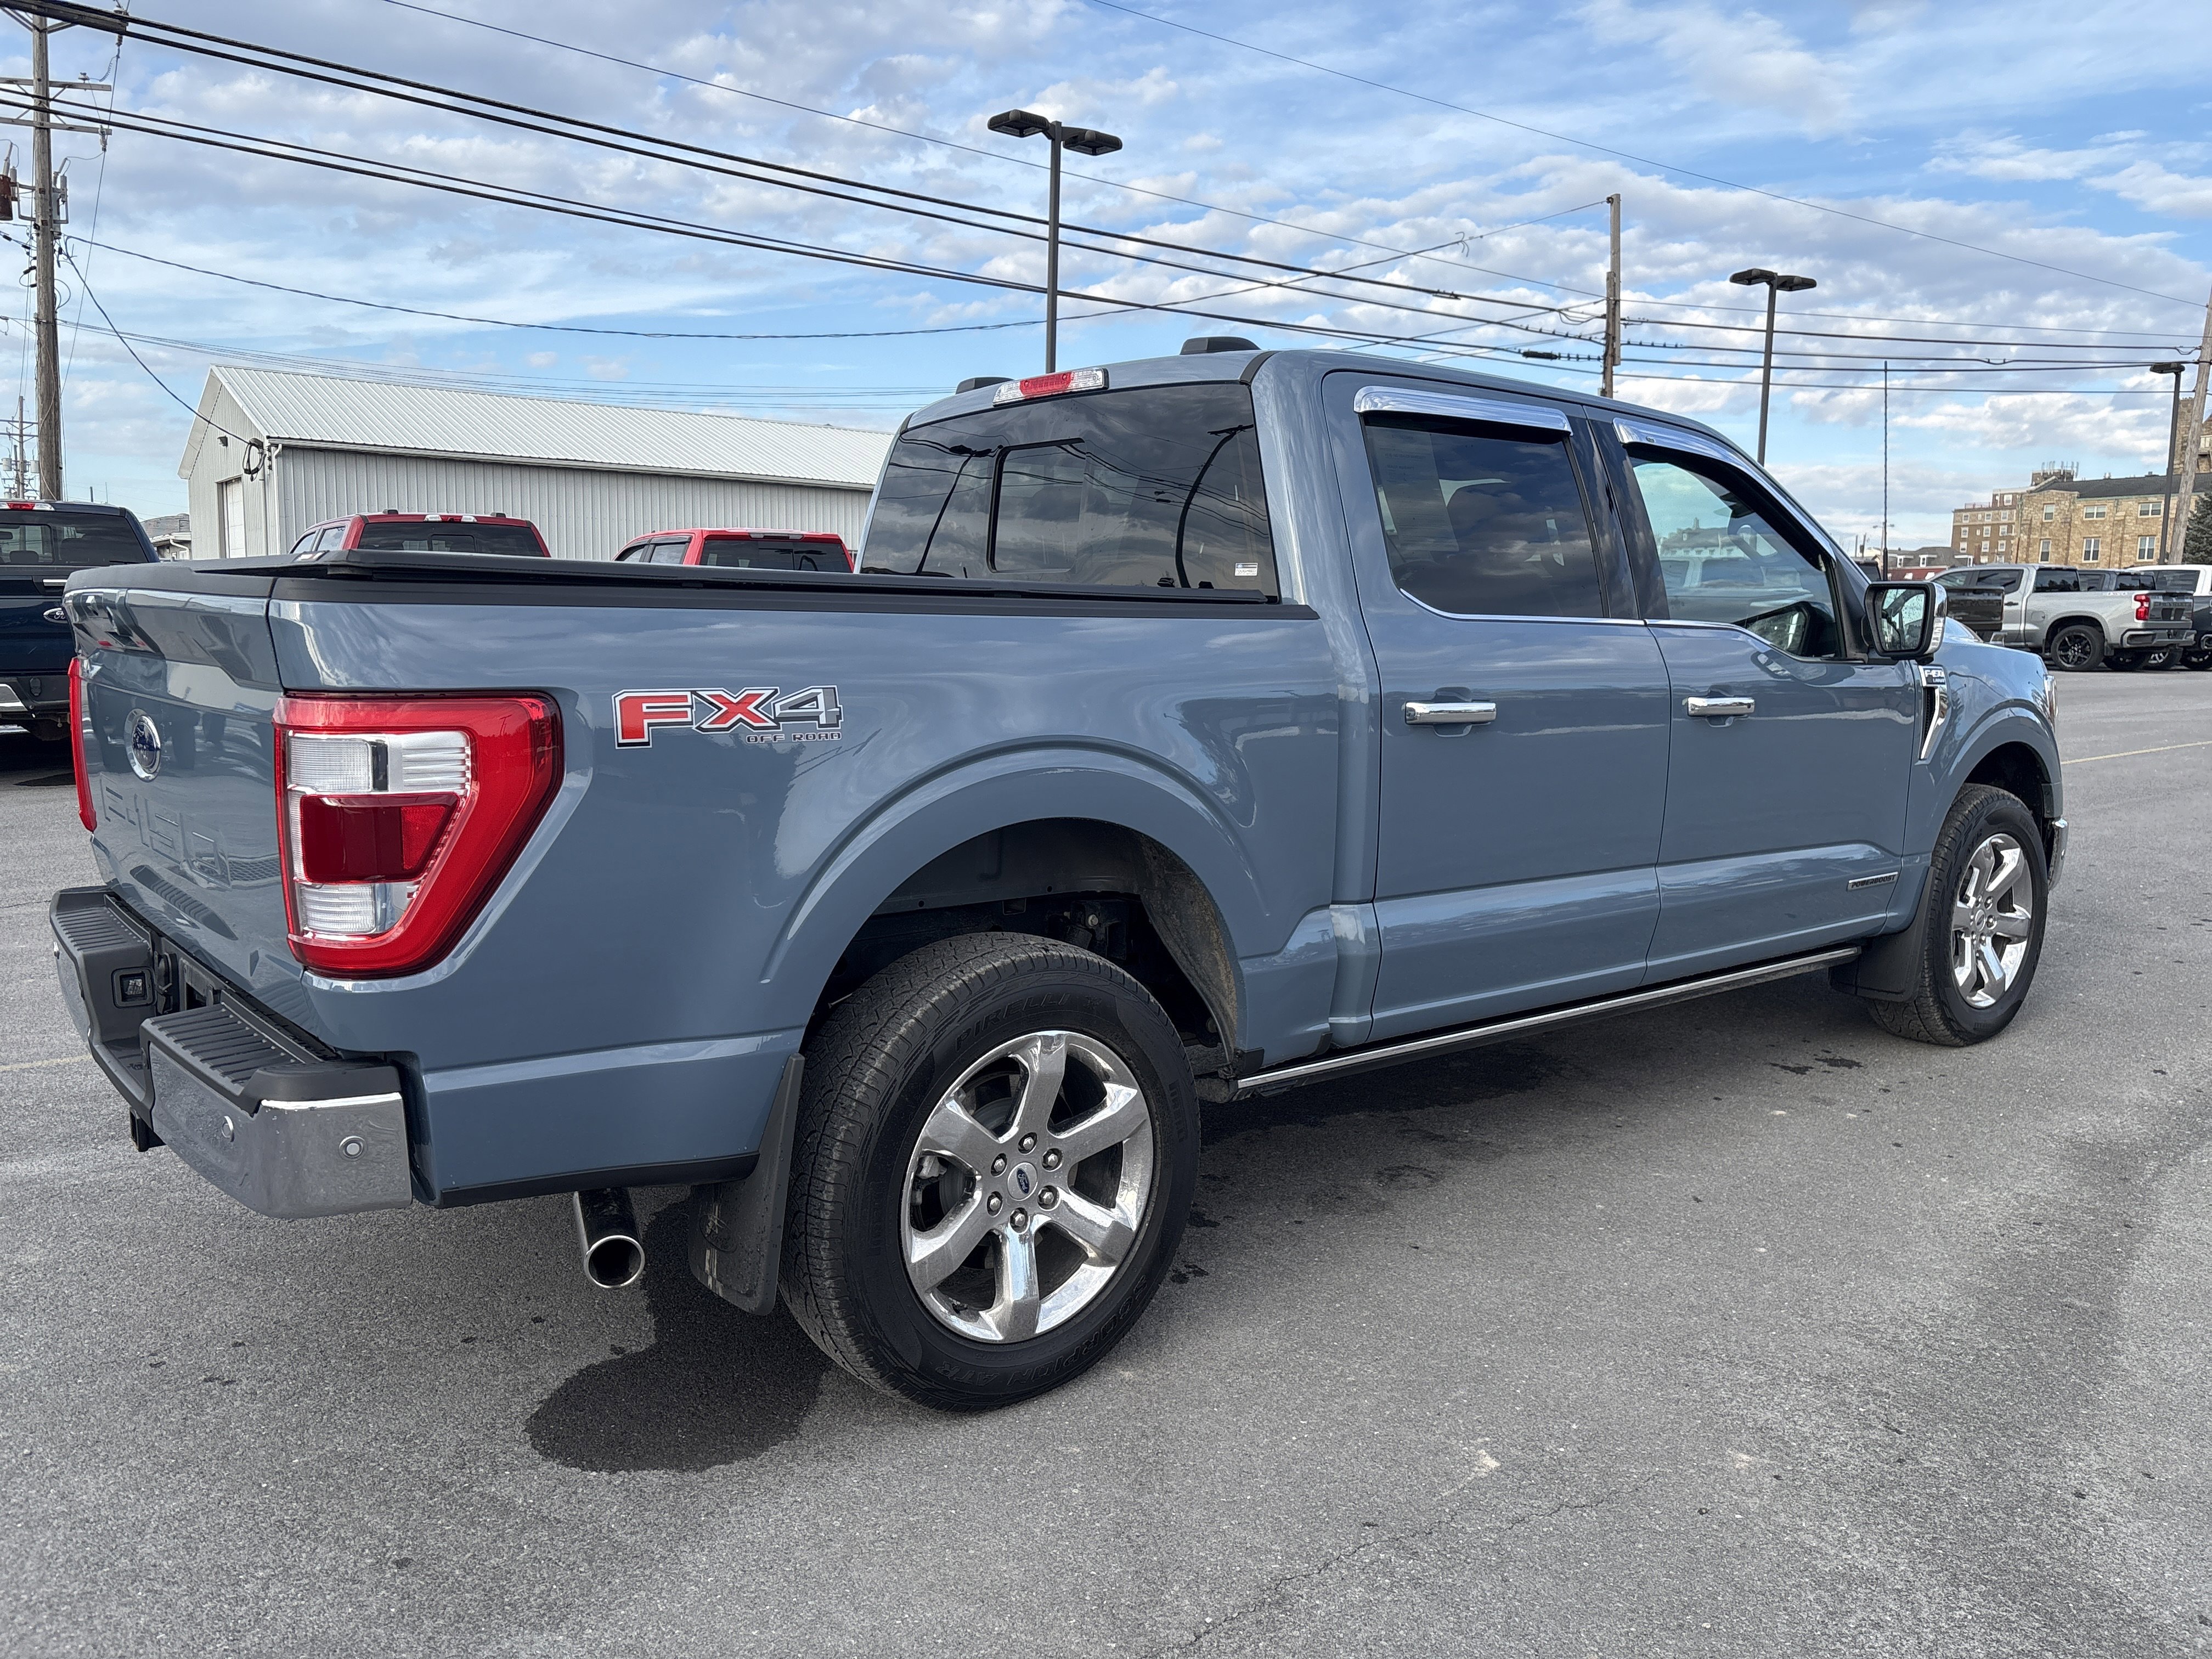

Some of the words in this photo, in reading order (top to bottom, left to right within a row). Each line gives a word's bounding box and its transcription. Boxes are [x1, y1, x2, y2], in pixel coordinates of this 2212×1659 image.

[611, 685, 844, 749] FX4
[746, 734, 785, 744] OFF
[792, 732, 842, 742] ROAD
[1851, 874, 1897, 888] POWERBOOST
[955, 991, 1071, 1052] PIRELLI
